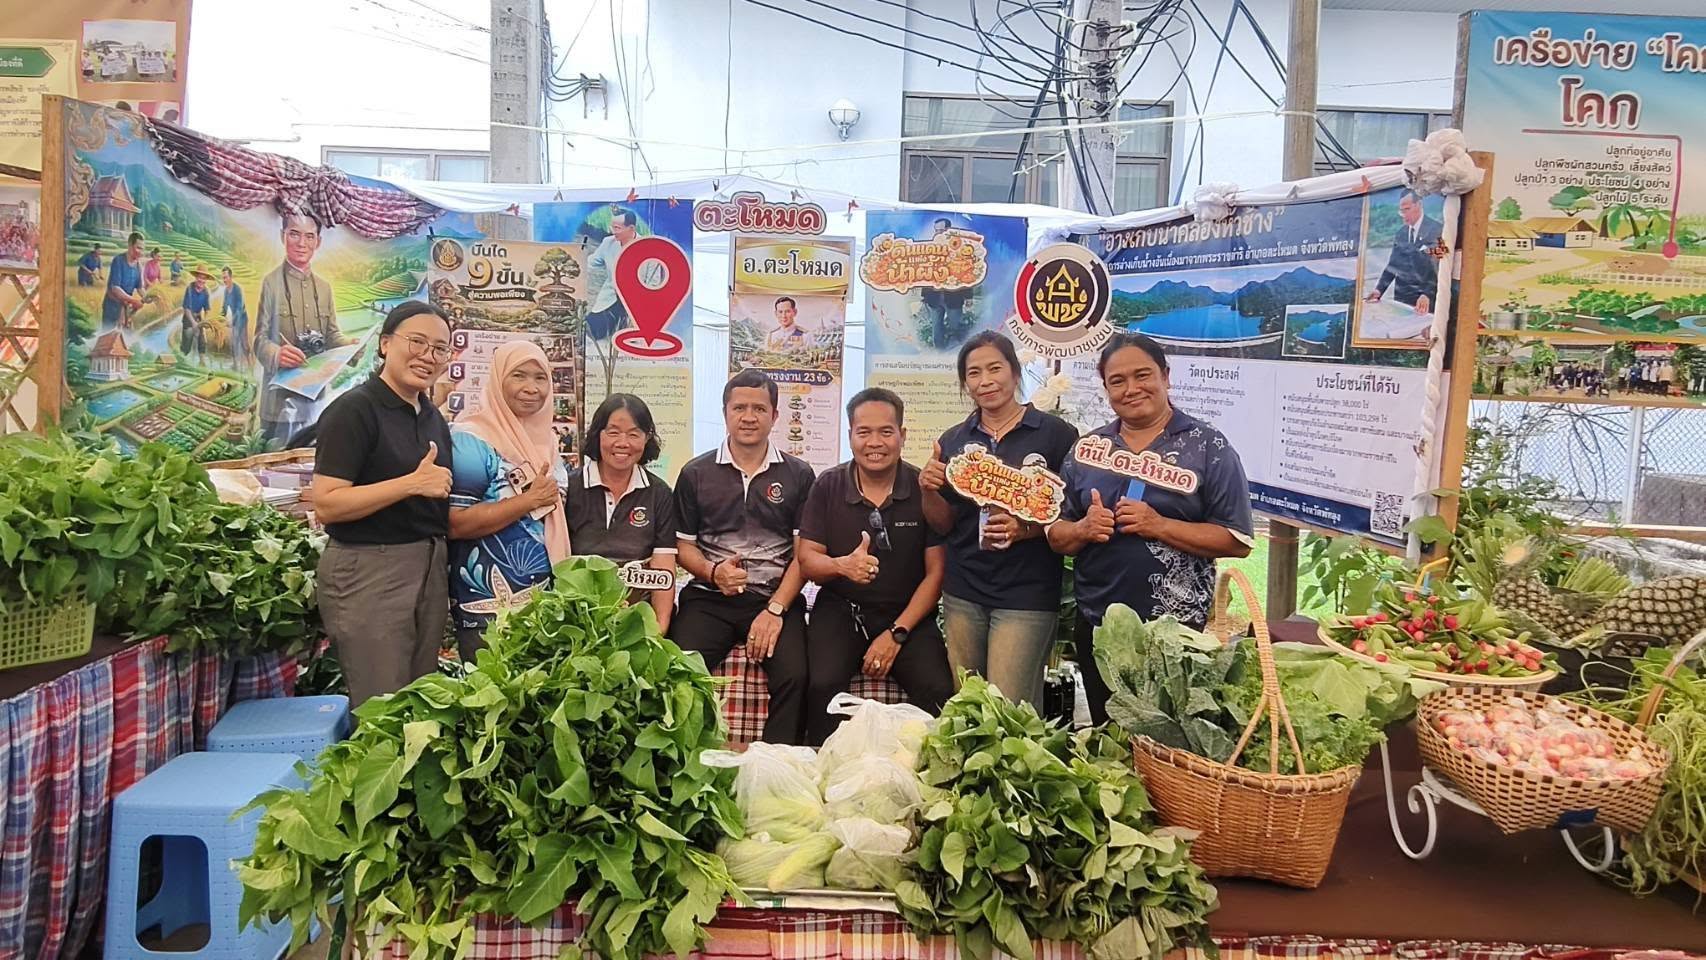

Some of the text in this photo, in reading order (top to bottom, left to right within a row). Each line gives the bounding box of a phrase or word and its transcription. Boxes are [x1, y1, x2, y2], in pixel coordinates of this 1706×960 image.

[1496, 29, 1706, 70] เครือข่าย “โค
[1560, 77, 1640, 128] โคก
[1606, 145, 1671, 159] ปลูกที่อยู่อาศัย
[1535, 158, 1671, 173] ปลูกพืชผักสวนครัว เลี้ยงสัตว์
[1514, 173, 1670, 189] ปลูกป่า 3 อย่าง ประโยชน์ 4 อย่าง
[1596, 191, 1668, 205] ปลูกไม้ 5 ระดับ
[699, 197, 822, 231] ตะโหมด
[471, 244, 507, 258] บันได
[891, 241, 949, 257] ดินแดน
[1300, 236, 1354, 257] จังหวัดพัทลุง
[744, 250, 843, 276] อ.ตะโหมด
[887, 255, 949, 283] น้ำผึ้ง
[496, 262, 524, 286] ขั้น
[456, 334, 465, 346] 9
[1008, 319, 1113, 358] กรมการพัฒนาชุมชน
[453, 365, 462, 378] 8
[766, 372, 801, 382] ทรงงาน
[803, 373, 815, 382] 23
[1189, 364, 1240, 383] วัตถุประสงค์
[1316, 370, 1400, 394] ประโยชน์ที่ได้รับ
[452, 396, 461, 408] 7
[979, 457, 1031, 488] ดินแดน
[1113, 454, 1192, 488] ตะโหมด
[970, 472, 1026, 510] น้ำผึ้ง
[620, 566, 668, 585] โหมด
